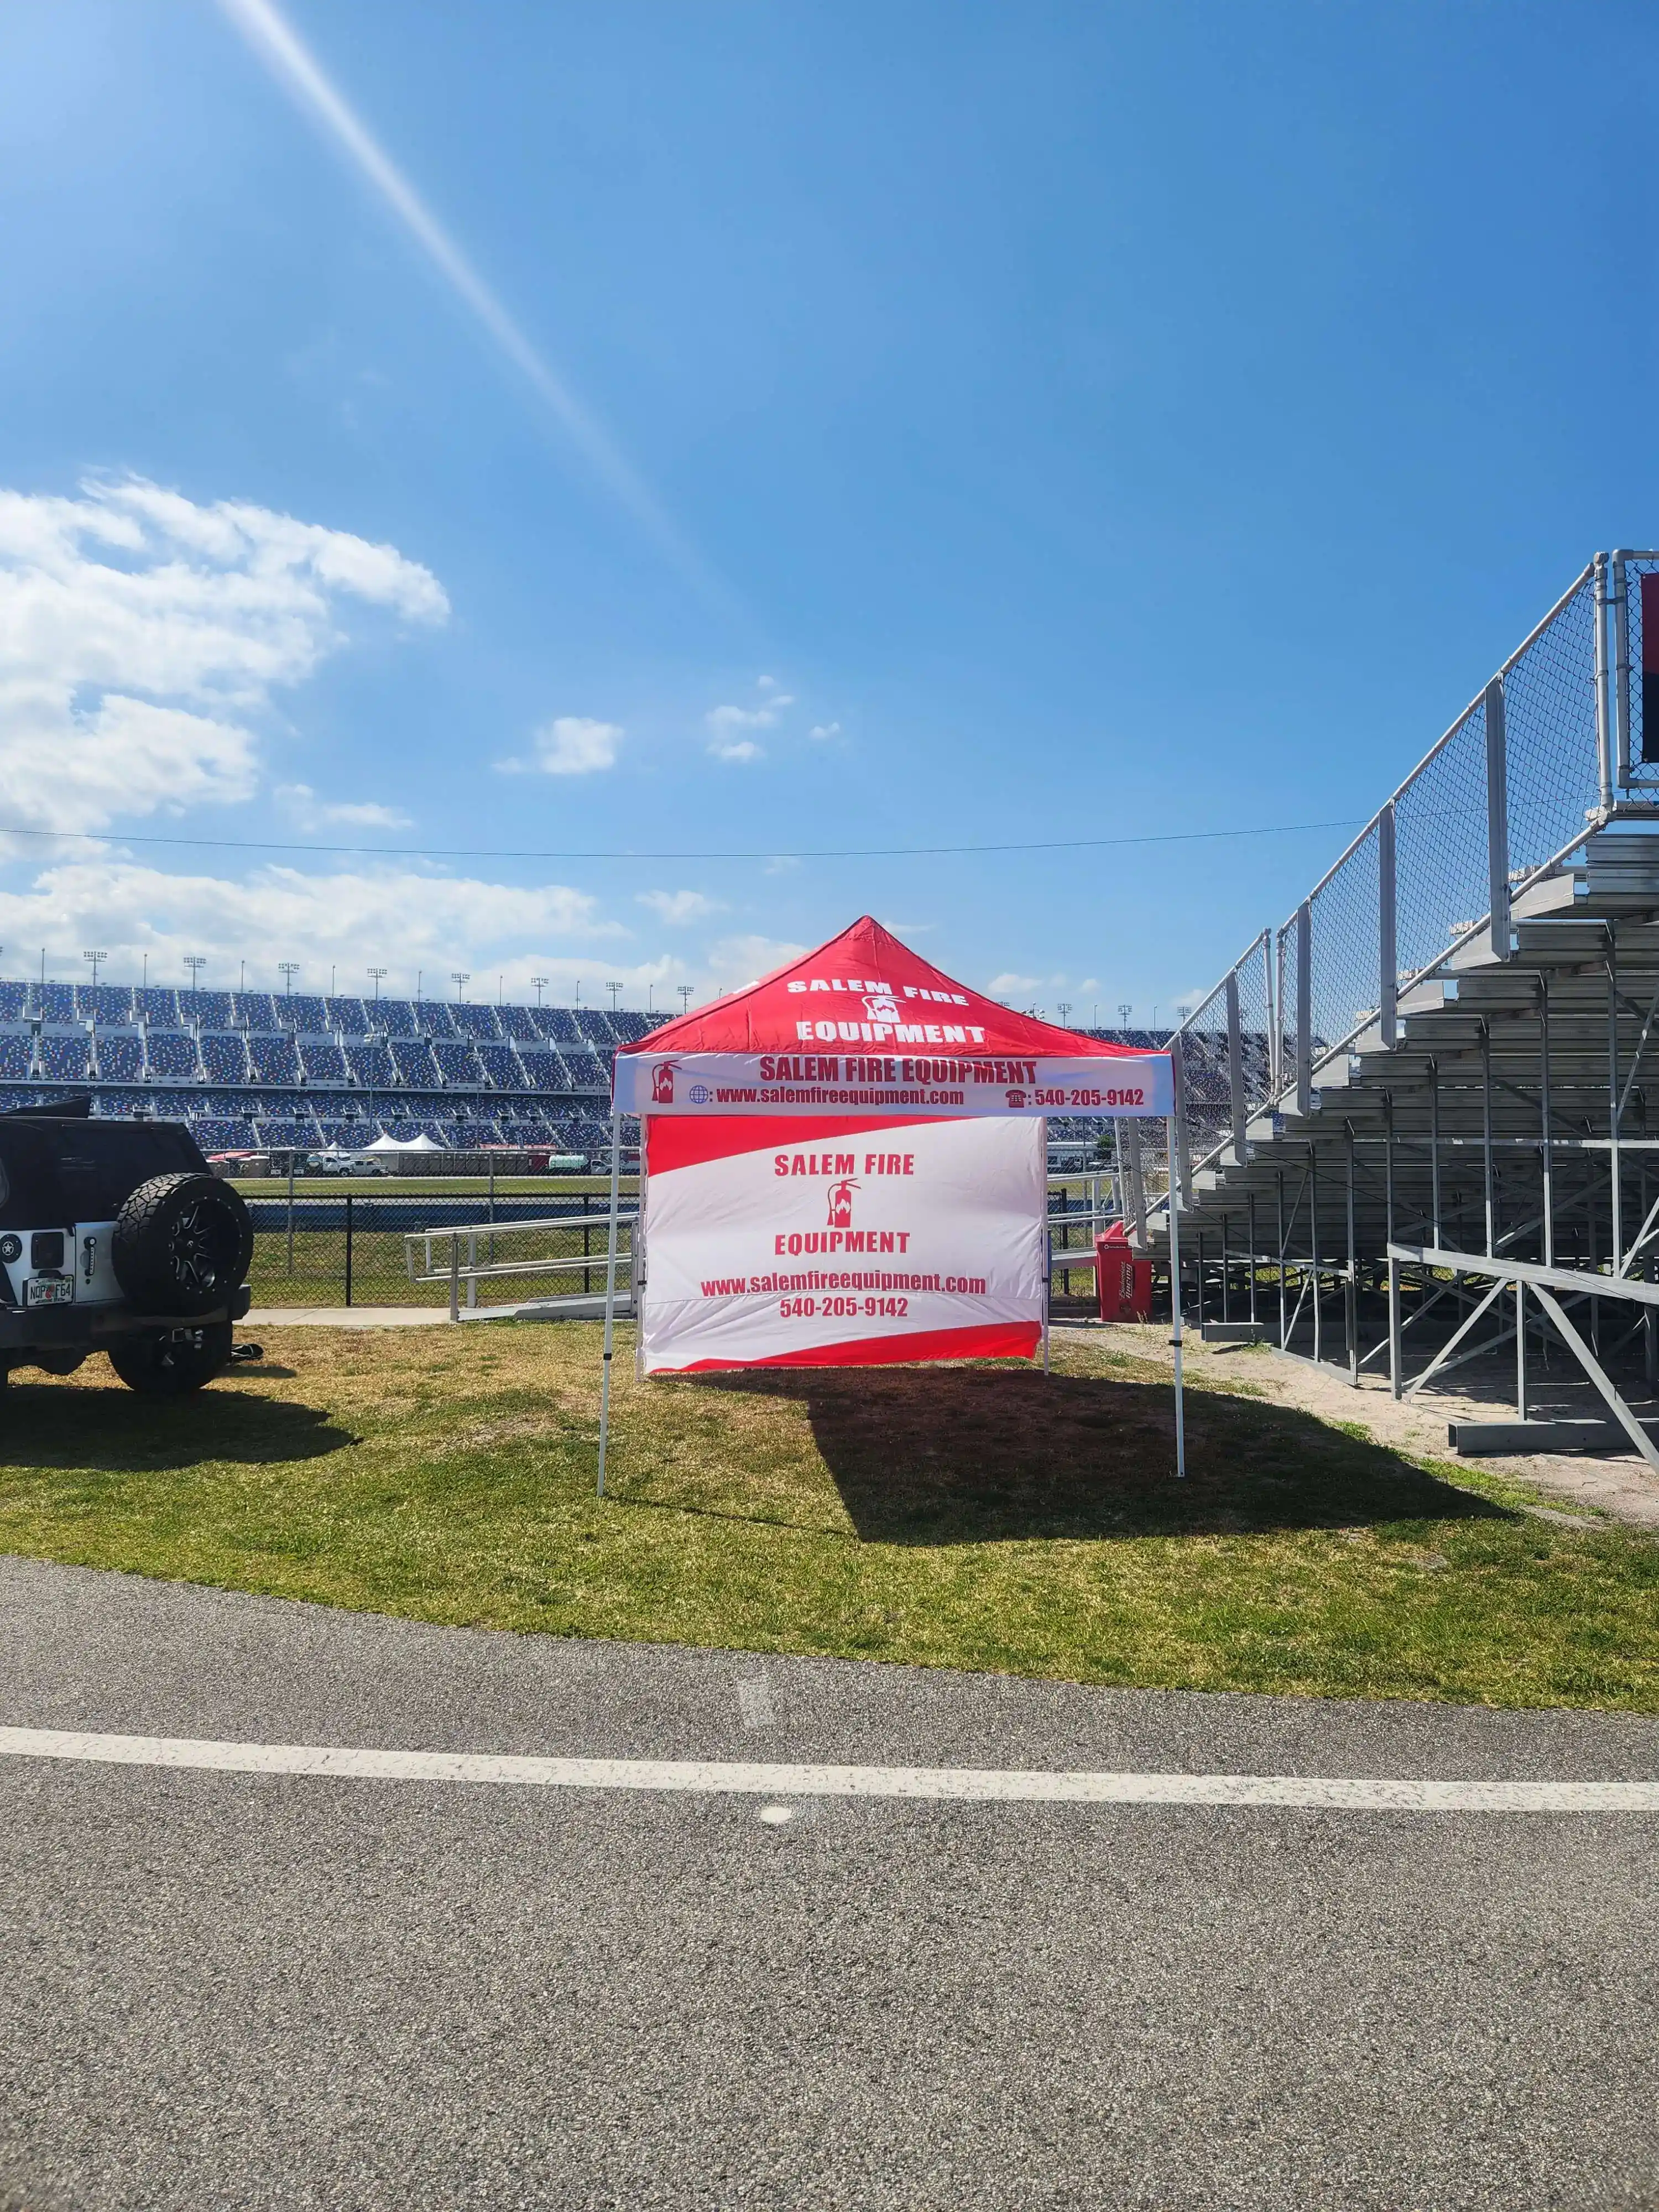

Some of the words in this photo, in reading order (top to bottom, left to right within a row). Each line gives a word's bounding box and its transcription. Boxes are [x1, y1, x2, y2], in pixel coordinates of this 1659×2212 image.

[787, 979, 893, 995] SALEM
[902, 986, 969, 1006] FIRE
[796, 1021, 985, 1044] EQUIPMENT
[760, 1057, 839, 1082] SALEM
[846, 1057, 896, 1082] FIRE
[902, 1058, 1037, 1085] EQUIPMENT
[716, 1086, 964, 1106] www.salemfireequipment.com
[1035, 1088, 1144, 1107] 540-205-9142
[775, 1154, 855, 1177] SALEM
[864, 1154, 915, 1176] FIRE
[775, 1232, 911, 1256] EQUIPMENT
[55, 1284, 70, 1297] F64
[701, 1270, 986, 1297] www.salemfireequipment.com
[780, 1297, 909, 1318] 540-205-9142
